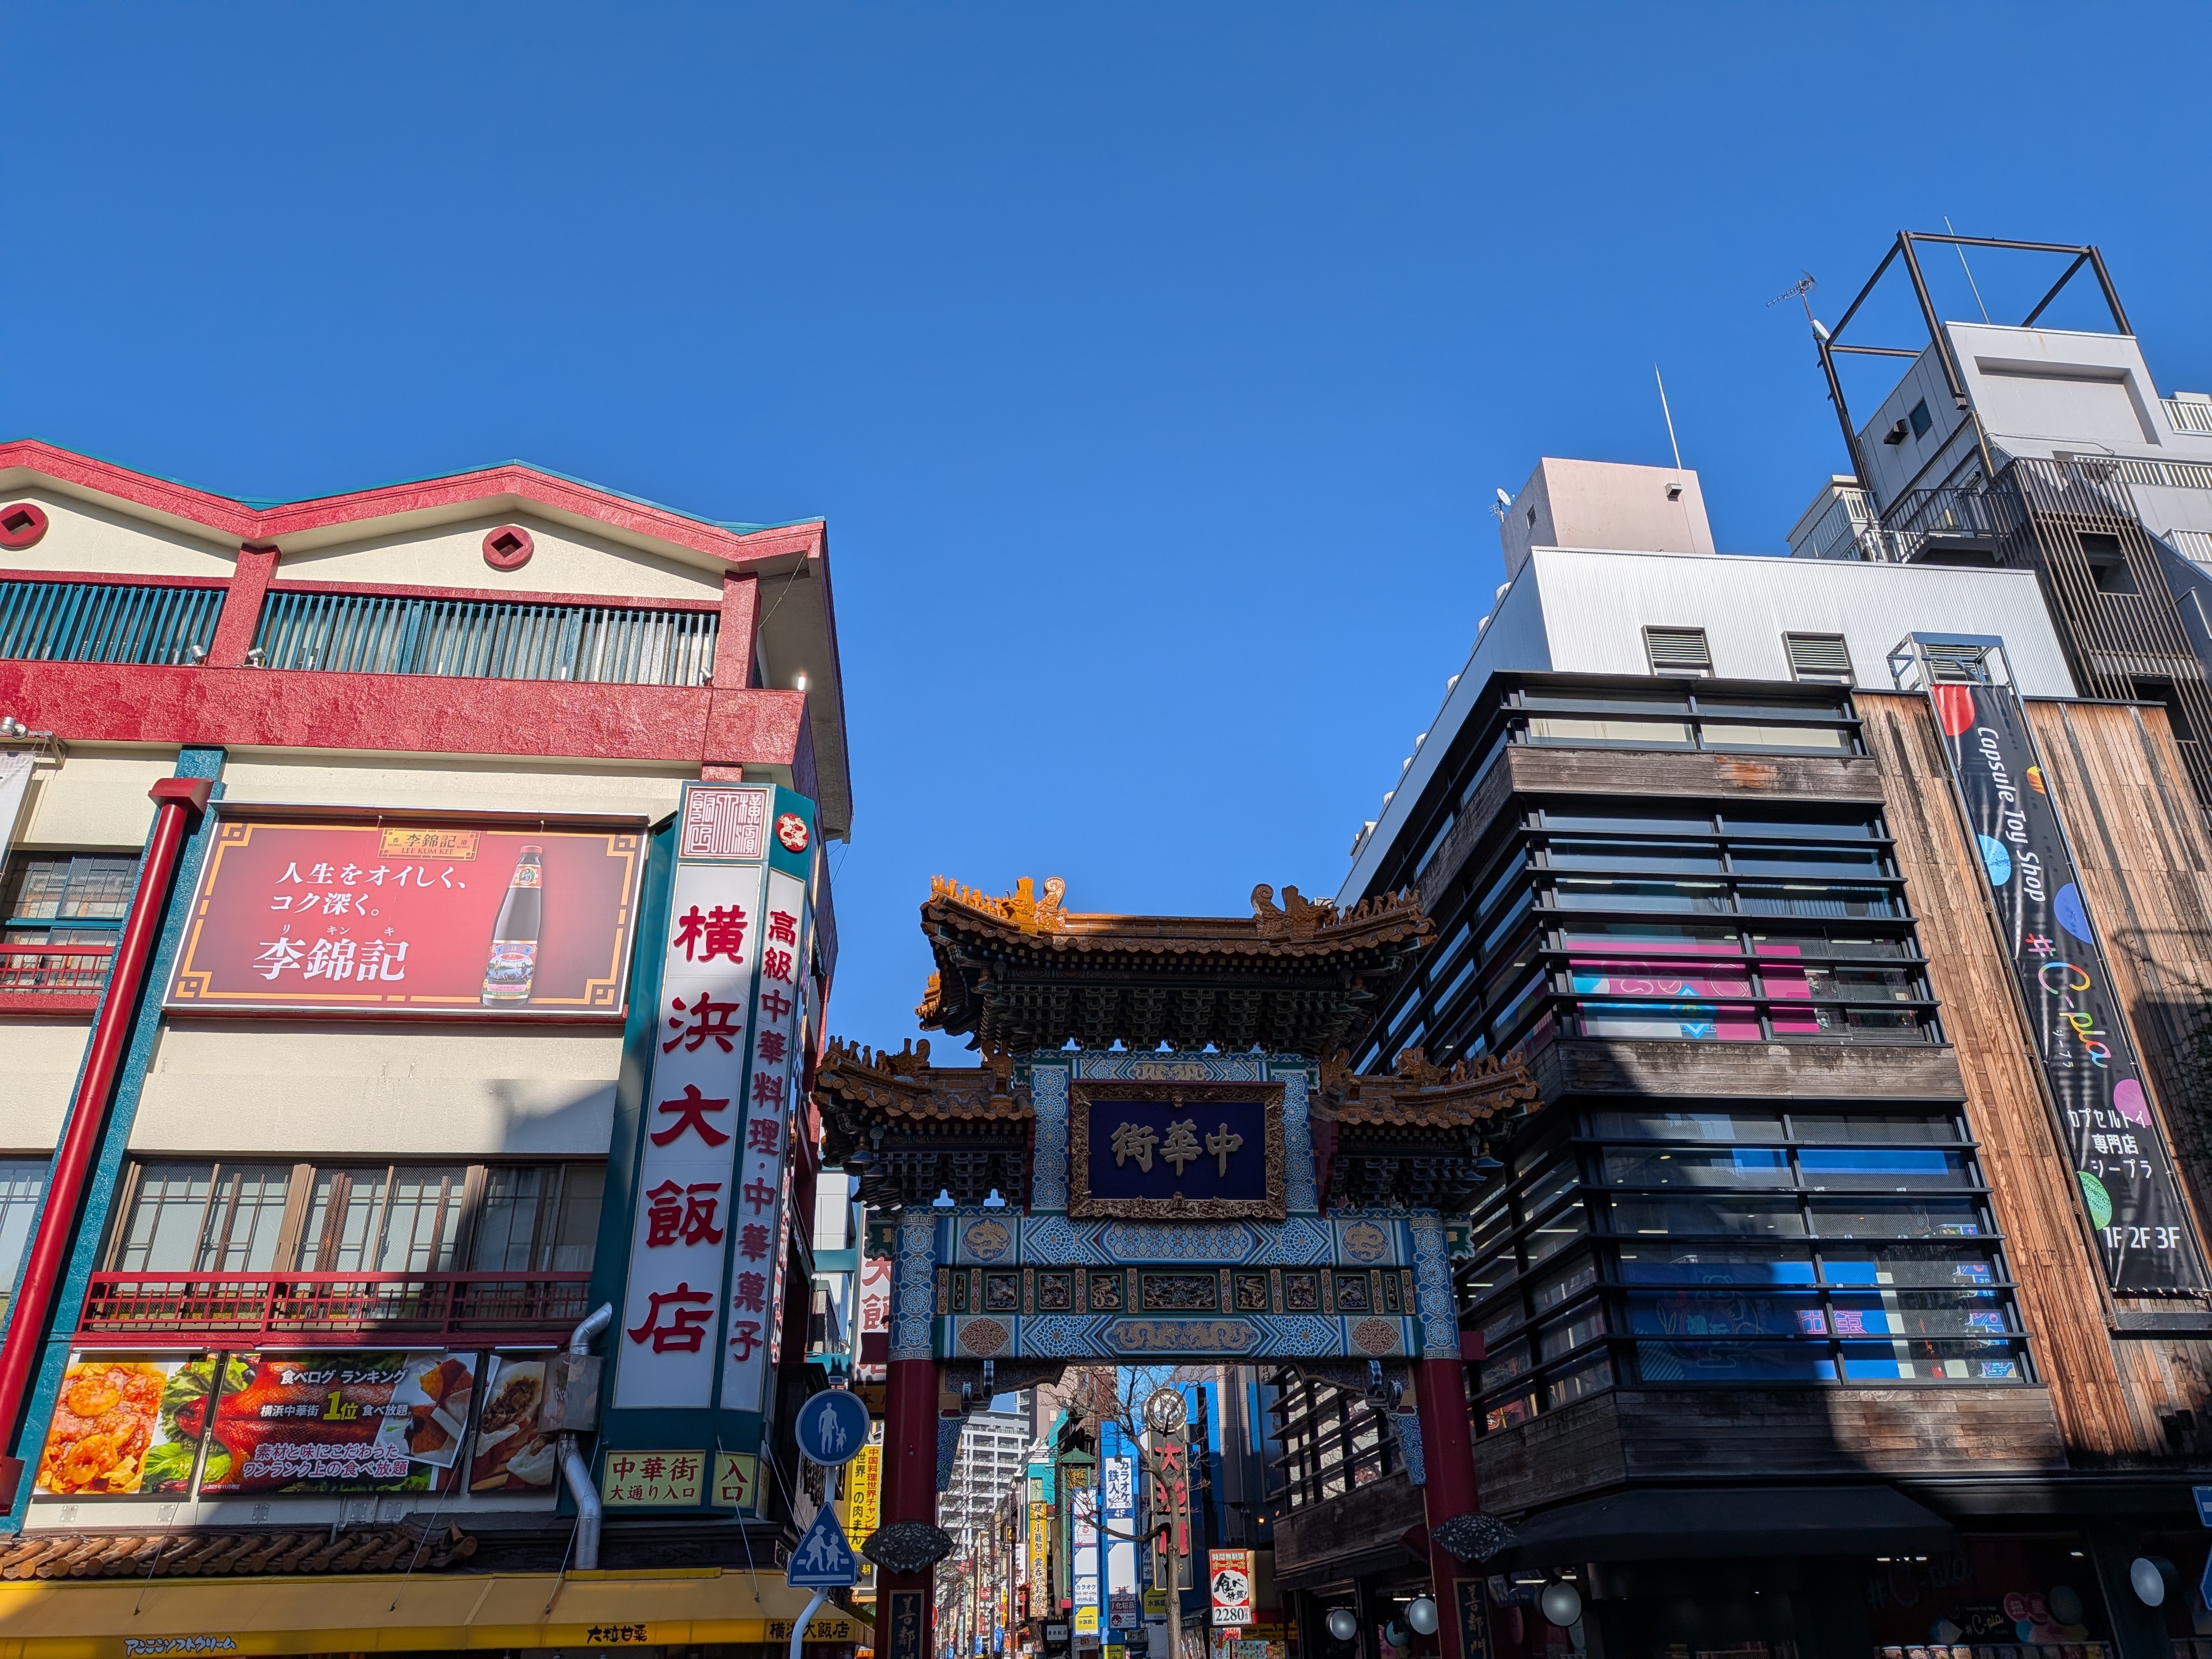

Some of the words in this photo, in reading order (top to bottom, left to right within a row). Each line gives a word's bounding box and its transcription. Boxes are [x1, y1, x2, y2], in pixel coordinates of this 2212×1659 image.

[1978, 726, 2015, 803] Capsule
[2004, 810, 2028, 844] Toy
[2016, 849, 2047, 902] Shop
[404, 834, 457, 848] 李錦記
[275, 862, 466, 889] 人生をオイしく、
[270, 892, 380, 916] コク深く。
[326, 925, 351, 936] キン
[252, 937, 409, 982] 李錦記
[2052, 1028, 2076, 1070] シープラ
[627, 905, 748, 1354] 横浜大飯店
[2067, 1108, 2147, 1130] カプセルトイ
[729, 910, 798, 1361] 高級中華料理・中華菓子
[2090, 1134, 2140, 1156] 専門店
[2091, 1158, 2152, 1180] シープラ
[2103, 1225, 2123, 1249] 1F
[2128, 1226, 2151, 1250] 2F
[2157, 1226, 2181, 1250] 3F
[280, 1369, 337, 1385] 食べログ
[340, 1369, 409, 1384] ランキング
[260, 1404, 320, 1418] 横浜中華街
[322, 1390, 359, 1420] 1位
[254, 1443, 400, 1460] 素材と味にこだわった
[242, 1459, 410, 1478] ワンランク上の食べ放題
[612, 1457, 700, 1483] 中華街
[719, 1458, 749, 1503] 入口
[1108, 1469, 1120, 1494] 鉄人
[608, 1485, 696, 1503] 大通り入口
[1114, 1509, 1126, 1518] 4F
[1214, 1572, 1245, 1594] 食べ
[1115, 1601, 1135, 1610] 化粧品
[1215, 1608, 1244, 1621] 2280
[587, 1624, 648, 1645] 大粒甘栗
[124, 1635, 237, 1657] アンニンソフトクリーム
